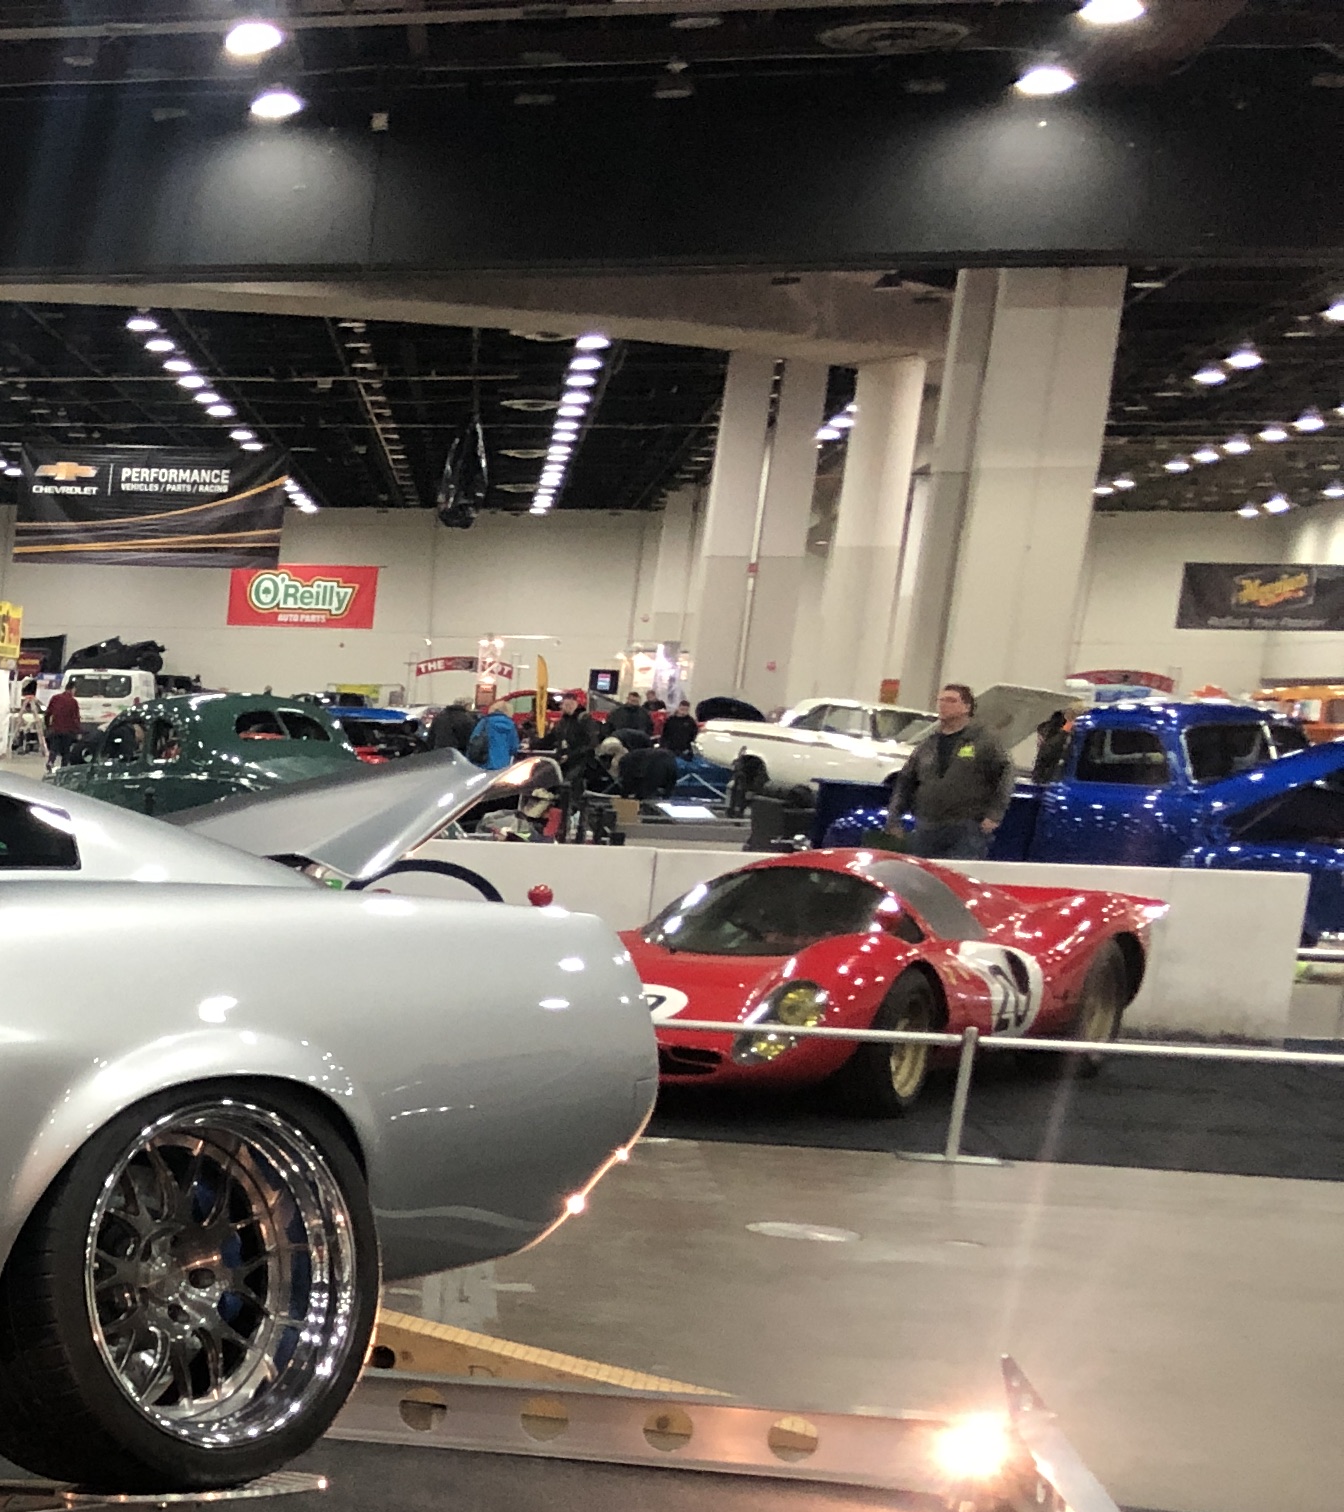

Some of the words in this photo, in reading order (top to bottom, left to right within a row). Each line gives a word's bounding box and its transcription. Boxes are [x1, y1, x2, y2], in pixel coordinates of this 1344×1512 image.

[121, 467, 231, 484] PERFORMANCE
[32, 484, 99, 495] CHEVROLET
[121, 483, 160, 492] VEHICLES
[166, 484, 192, 492] PARTS
[199, 484, 229, 493] RACING
[254, 576, 349, 610] O'Reilly
[277, 613, 299, 622] AUTO
[300, 614, 326, 623] PARTS
[419, 660, 445, 674] THE
